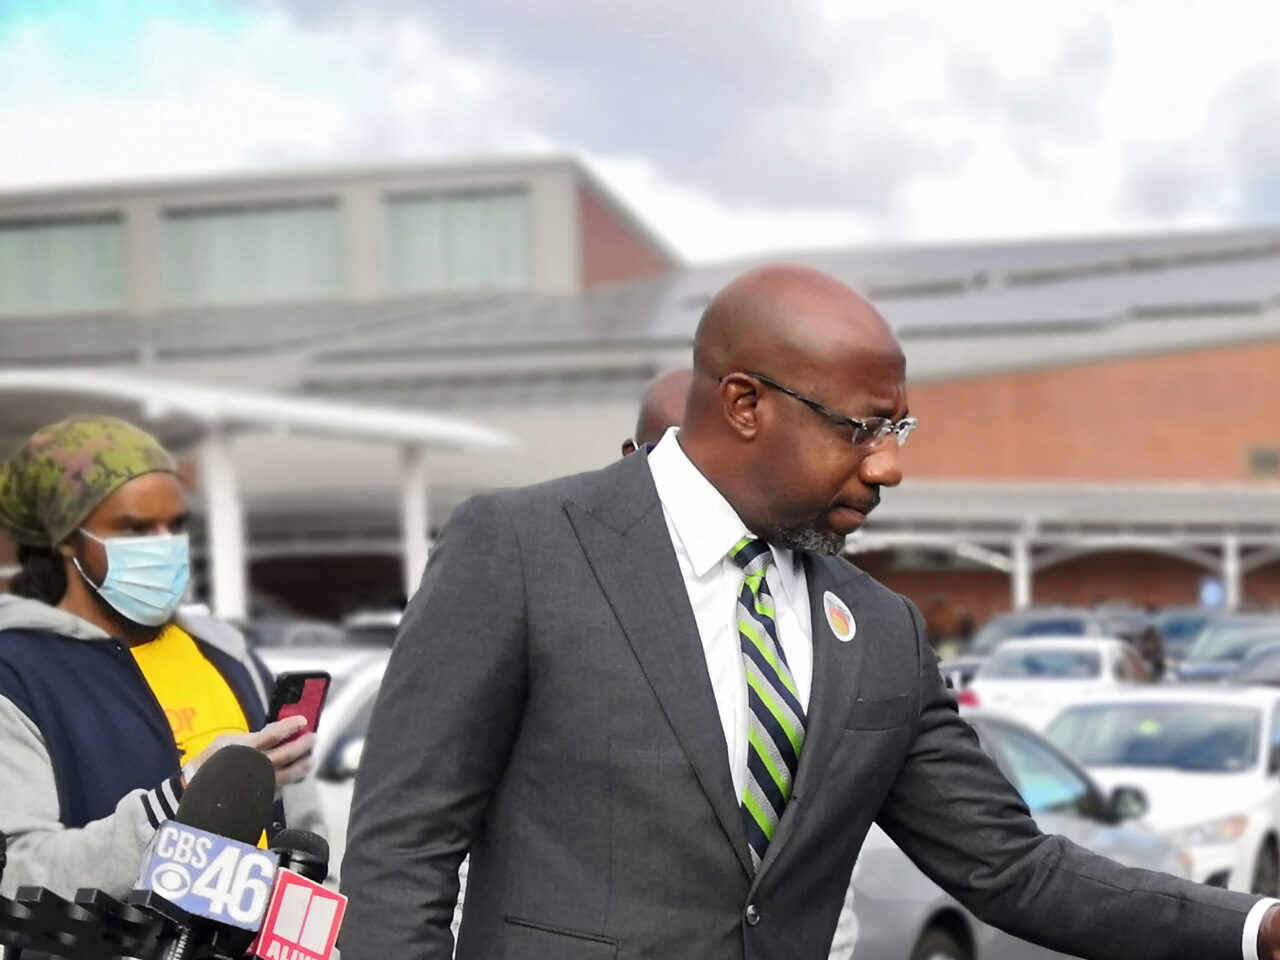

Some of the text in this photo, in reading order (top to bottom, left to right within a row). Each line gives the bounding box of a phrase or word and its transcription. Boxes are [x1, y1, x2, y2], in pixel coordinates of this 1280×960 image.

[157, 826, 275, 923] CBS 46
[272, 882, 339, 956] 11
